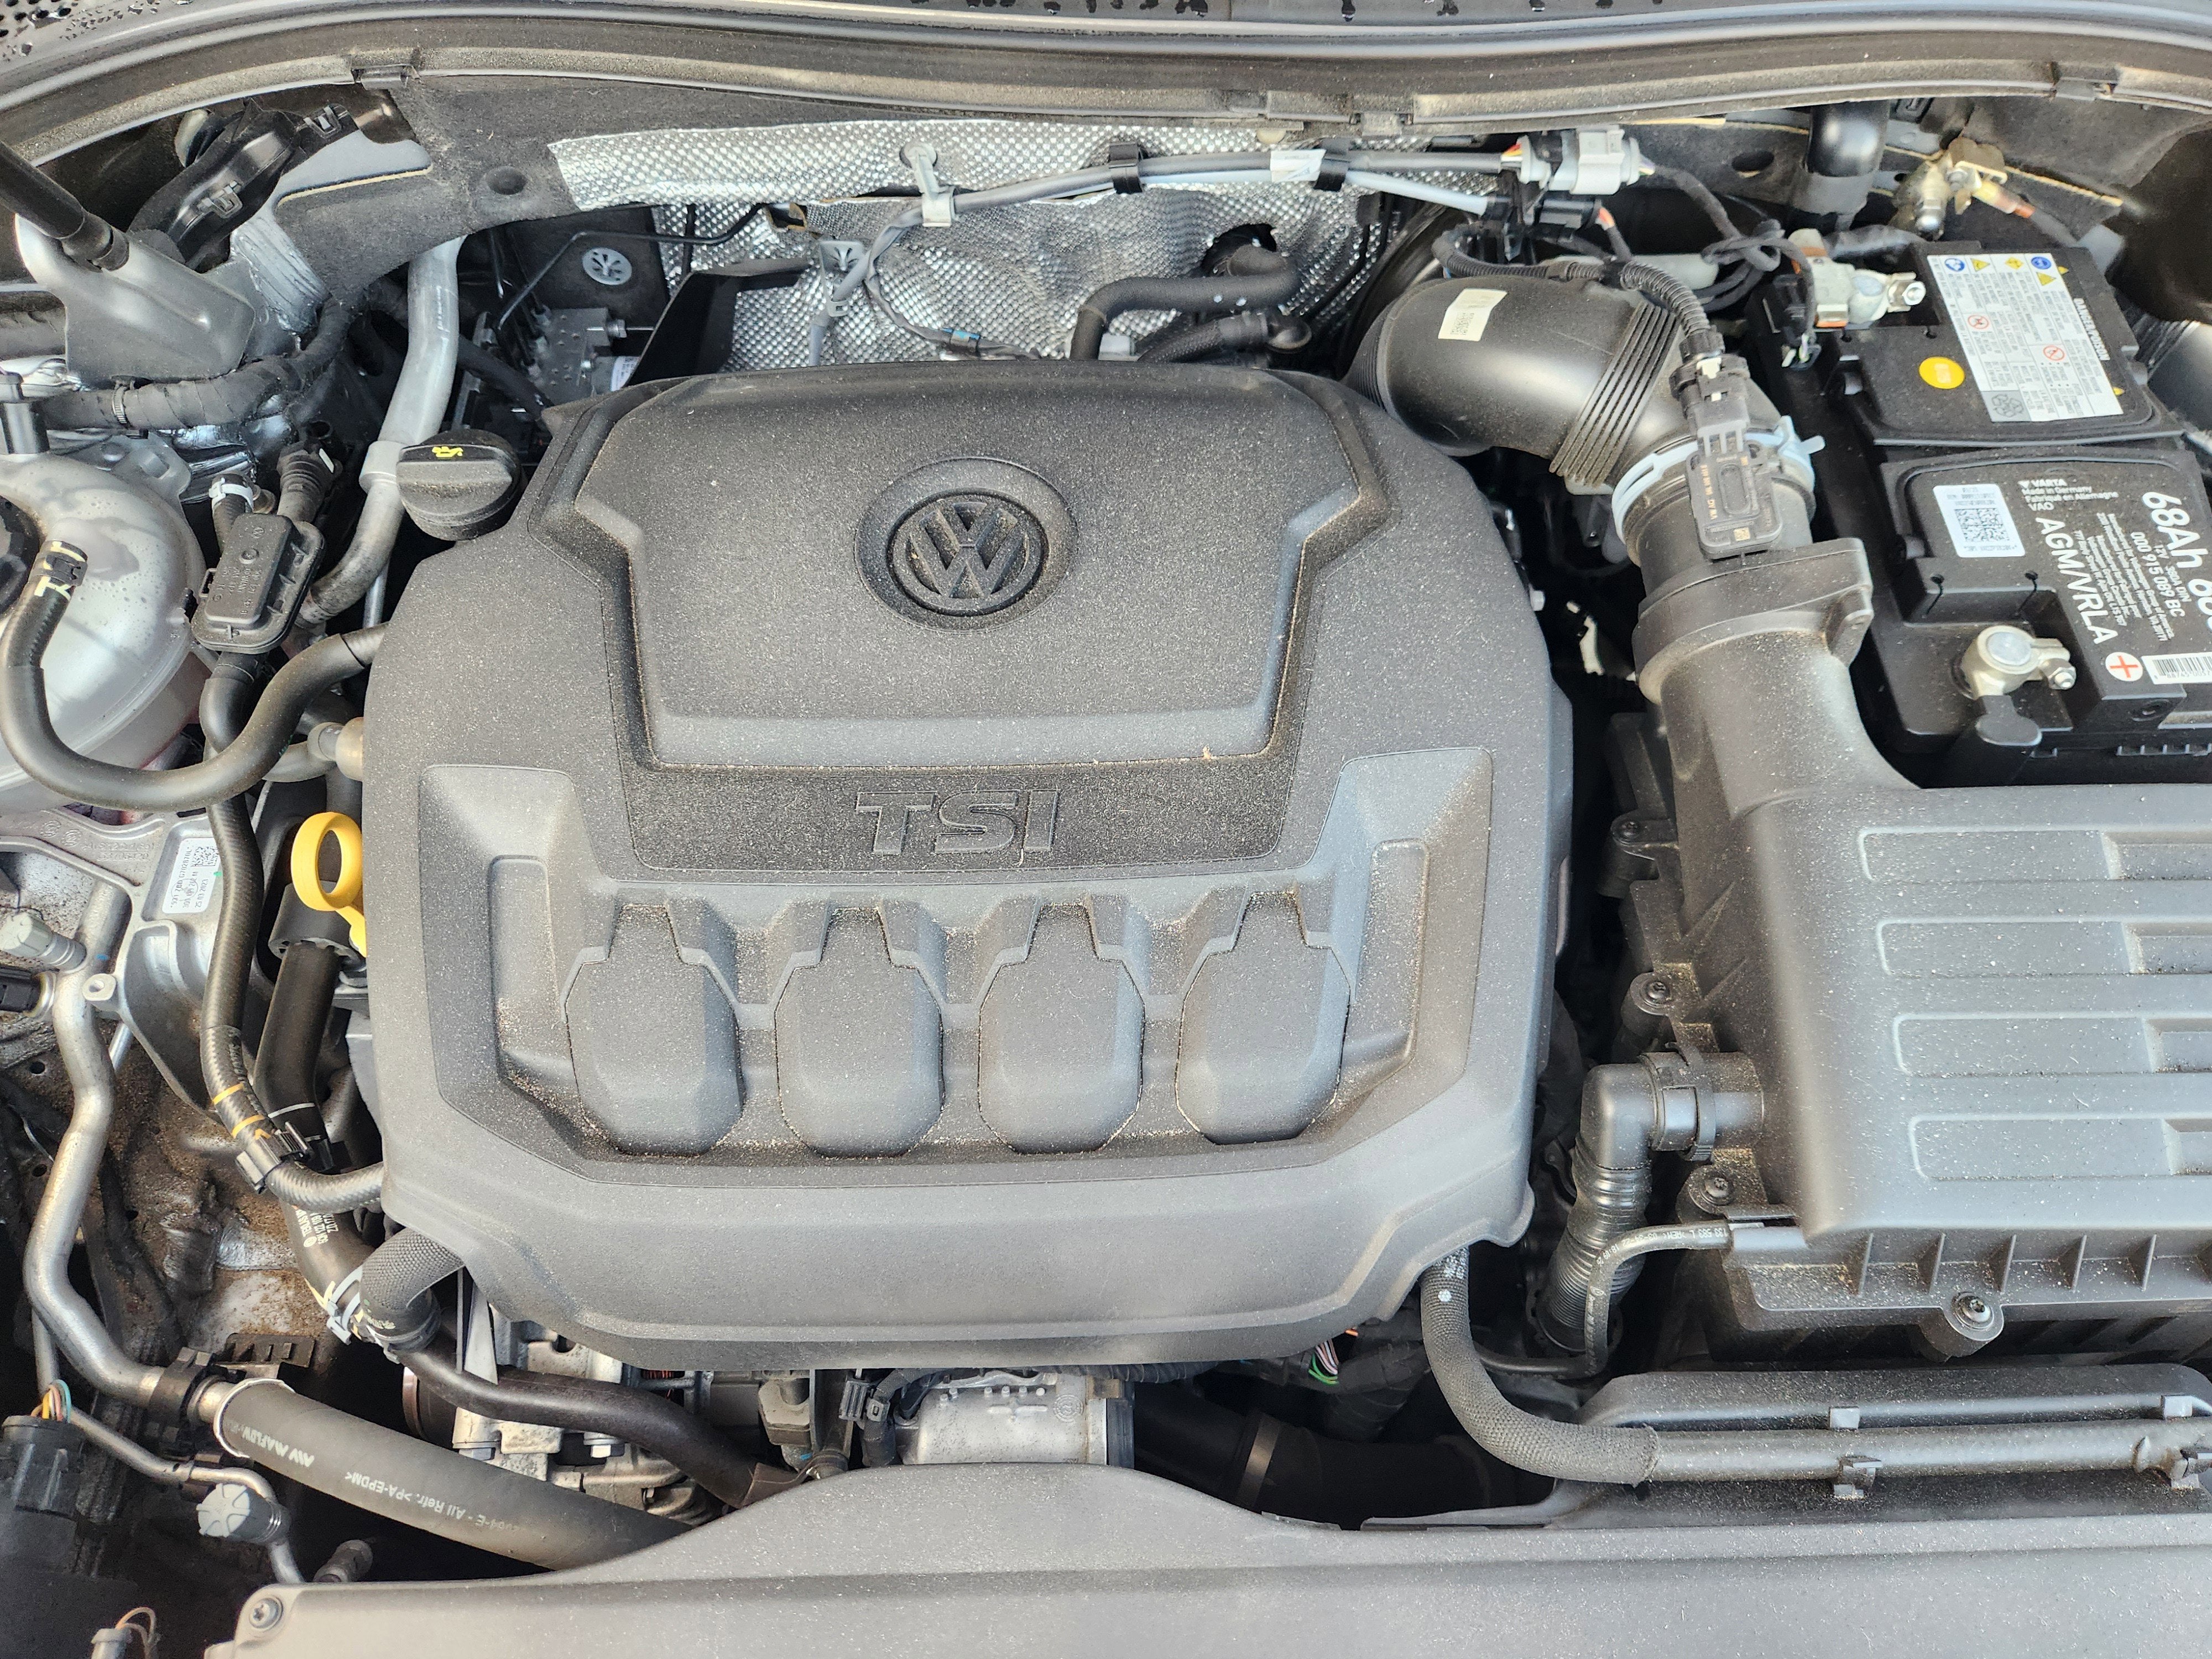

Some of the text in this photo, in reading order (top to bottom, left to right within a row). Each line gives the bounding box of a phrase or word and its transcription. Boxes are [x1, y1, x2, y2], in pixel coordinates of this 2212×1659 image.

[2031, 478, 2067, 488] VARTA
[2054, 486, 2092, 494] Germany
[2142, 492, 2209, 568] 68Ah
[2036, 517, 2119, 644] AGM/VRLA
[2131, 531, 2185, 618] 000 915 089 BC
[2176, 586, 2192, 603] DIN
[855, 789, 1060, 855] TSI
[1689, 1230, 1696, 1239] L
[345, 1471, 413, 1502] >PA-EPDM<
[416, 1493, 446, 1514] Refr.
[446, 1505, 466, 1520] All
